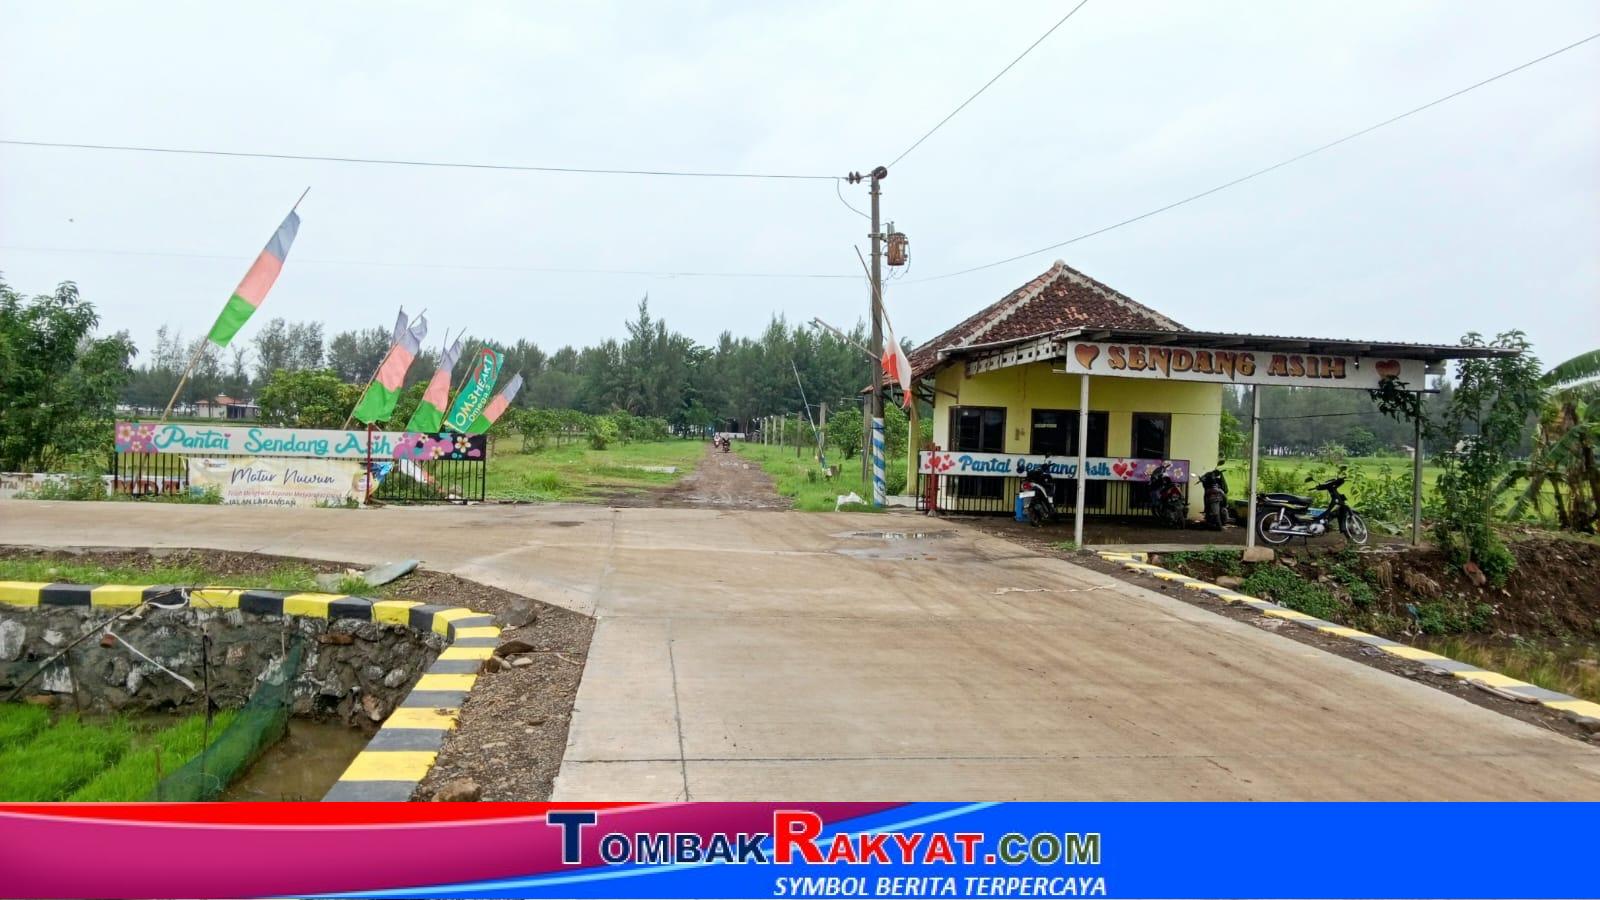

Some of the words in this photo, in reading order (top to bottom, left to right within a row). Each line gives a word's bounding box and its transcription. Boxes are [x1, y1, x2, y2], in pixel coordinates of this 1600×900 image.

[1107, 344, 1256, 381] SENDANG
[1267, 353, 1347, 379] ASIH
[154, 424, 231, 450] Pantai
[244, 428, 329, 455] Sendang
[231, 467, 276, 485] Matur
[283, 468, 335, 485] Nuwun
[958, 455, 1011, 473] Pantai
